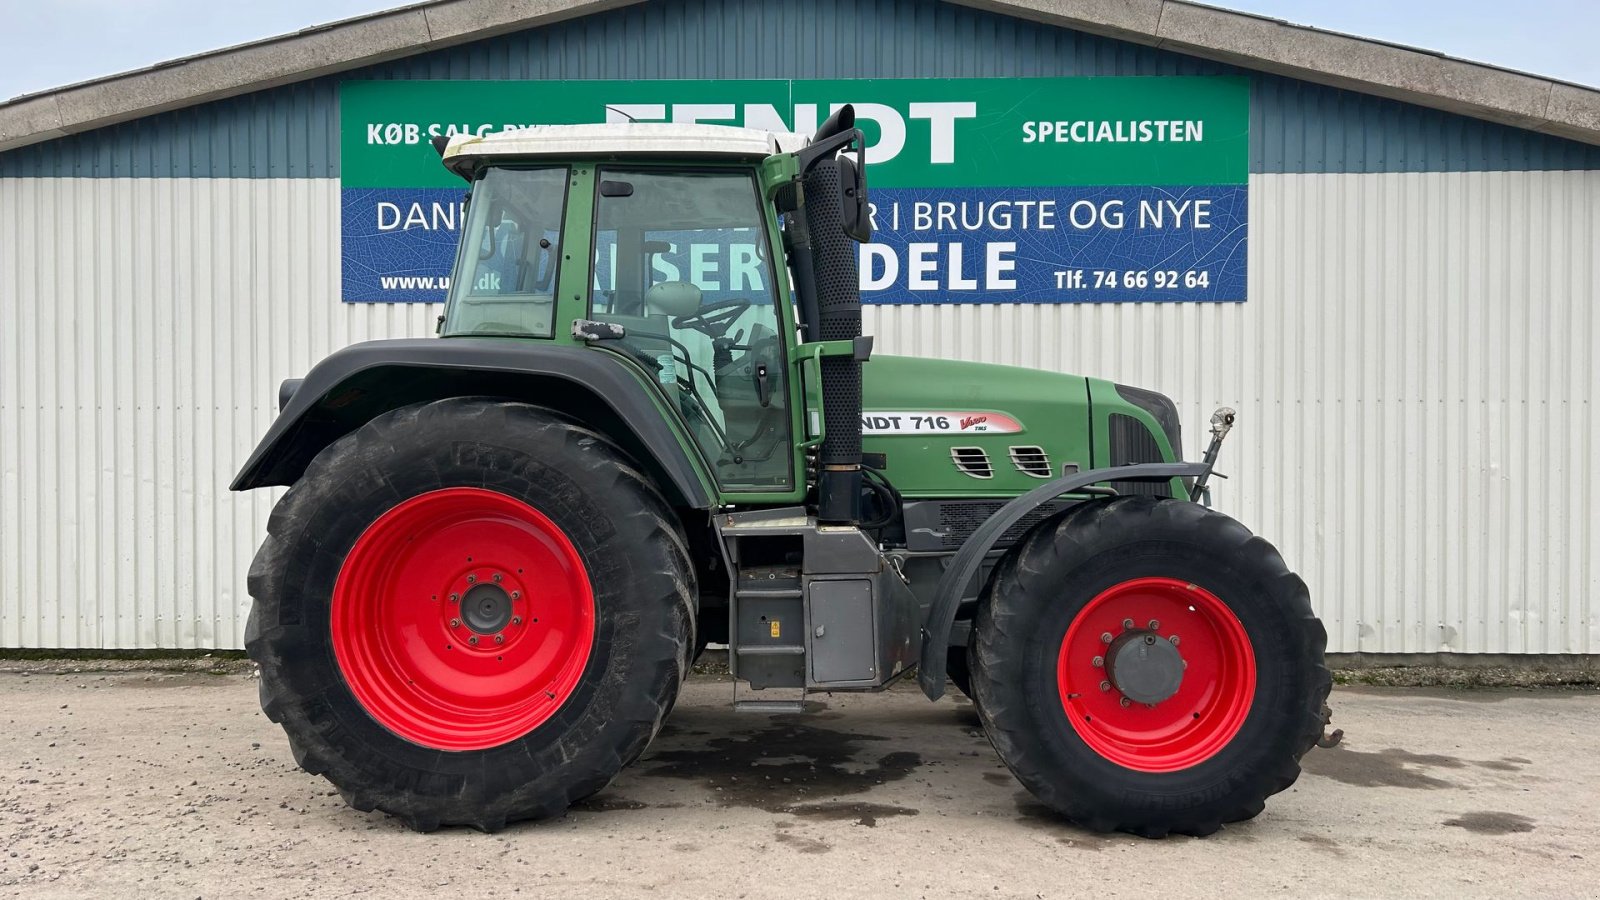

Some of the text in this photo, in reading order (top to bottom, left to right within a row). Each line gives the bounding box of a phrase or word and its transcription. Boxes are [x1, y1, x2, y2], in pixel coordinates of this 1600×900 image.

[1023, 121, 1203, 142] SPECIALISTEN
[914, 200, 1056, 231] BRUGTE
[1069, 200, 1124, 229] OG
[1139, 199, 1212, 229] NYE
[1053, 270, 1210, 289] Tlf. 74 66 92 64
[909, 416, 950, 430] 716
